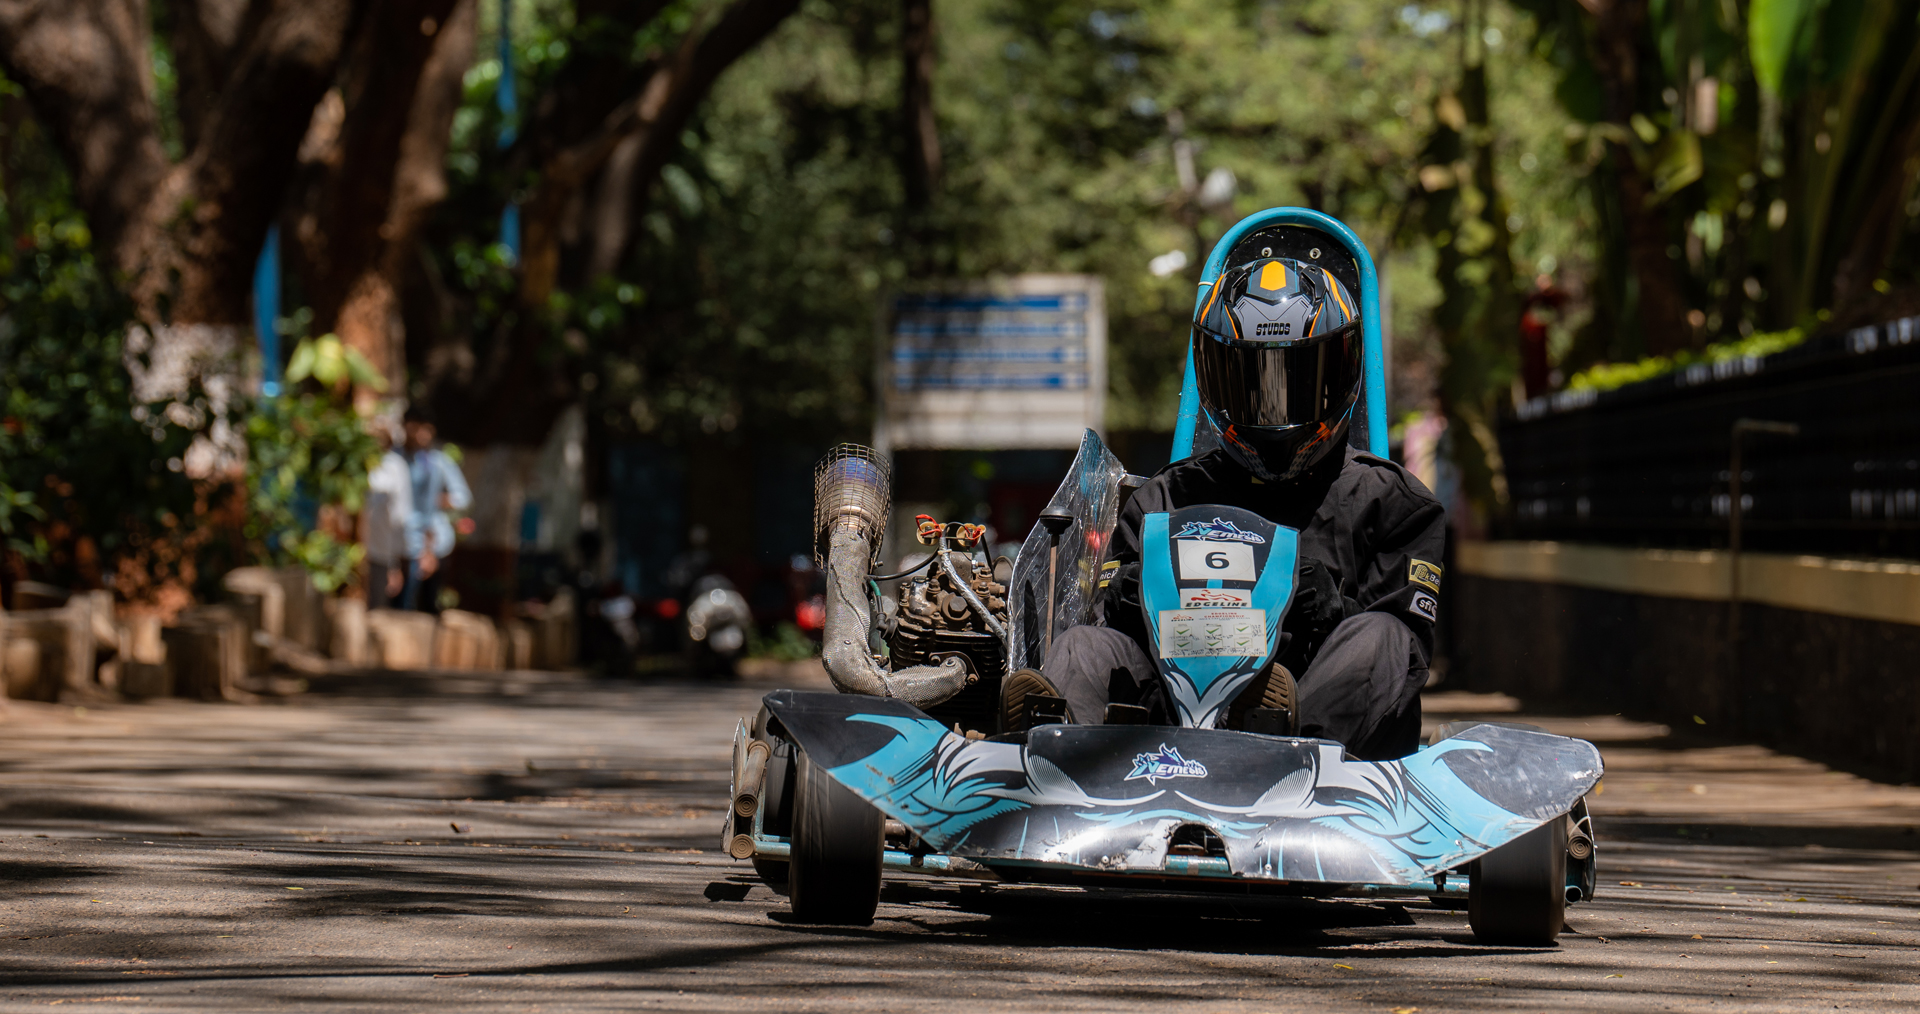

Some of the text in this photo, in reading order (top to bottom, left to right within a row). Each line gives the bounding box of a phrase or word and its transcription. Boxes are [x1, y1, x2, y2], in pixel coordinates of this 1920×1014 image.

[1256, 323, 1291, 336] STUDDS
[1205, 551, 1230, 570] 6
[1126, 752, 1208, 779] NEMESIS
